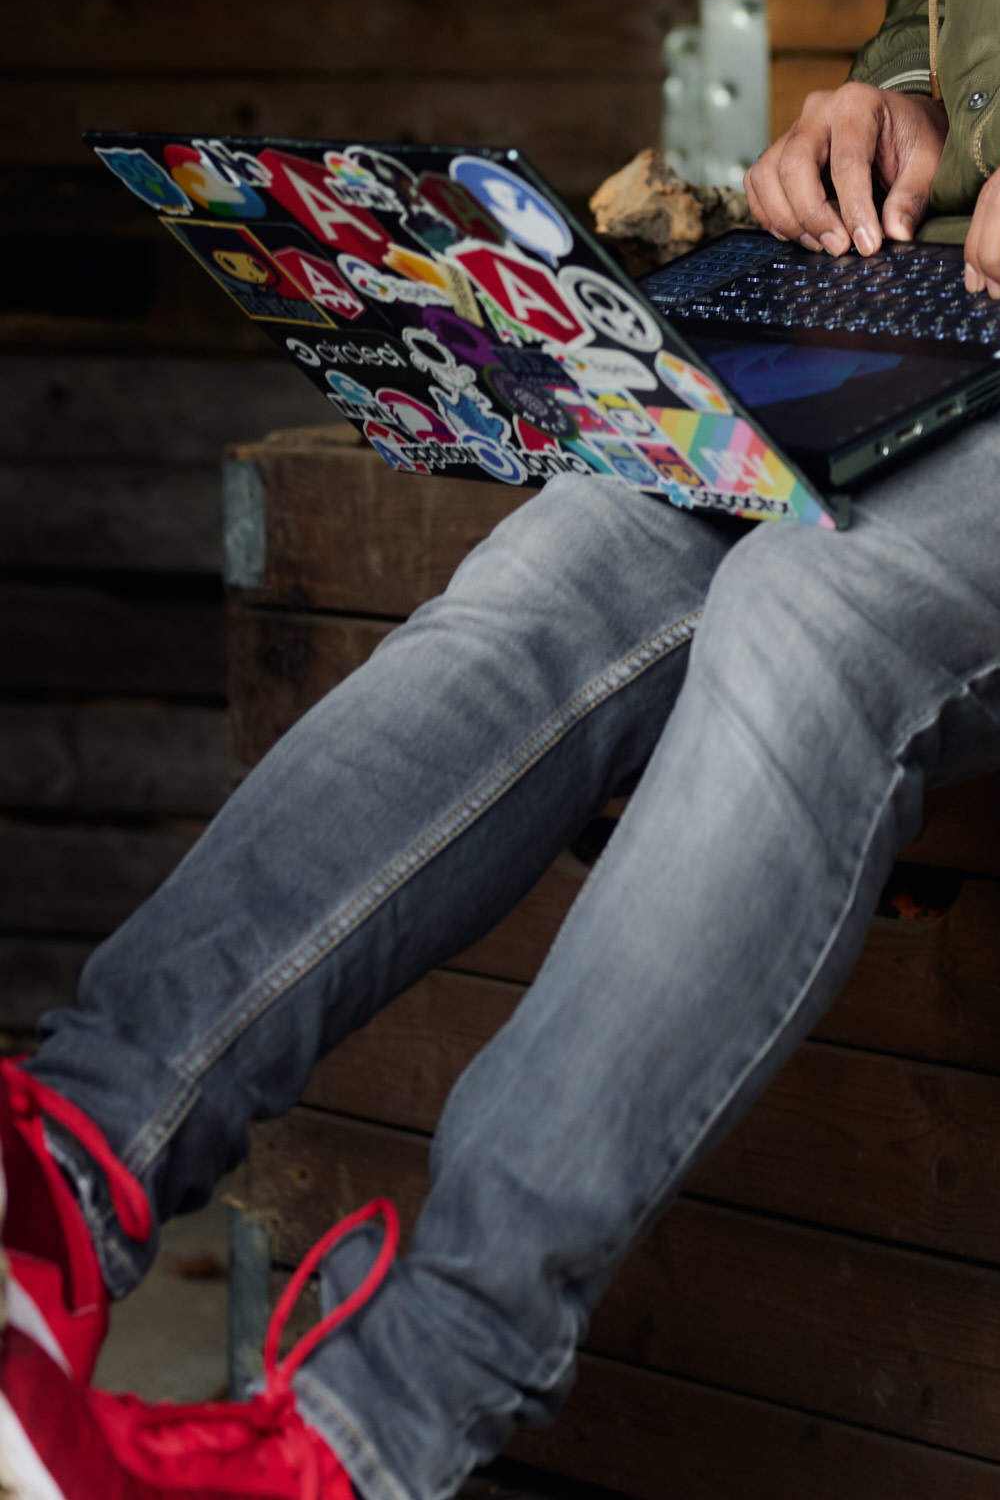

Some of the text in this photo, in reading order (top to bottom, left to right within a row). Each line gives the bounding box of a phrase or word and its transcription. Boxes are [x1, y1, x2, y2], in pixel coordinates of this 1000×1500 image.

[280, 164, 382, 240] A
[493, 259, 577, 331] A
[316, 340, 407, 368] circleci
[400, 440, 479, 467] appflow
[506, 443, 588, 476] ionic
[699, 447, 778, 487] DEV
